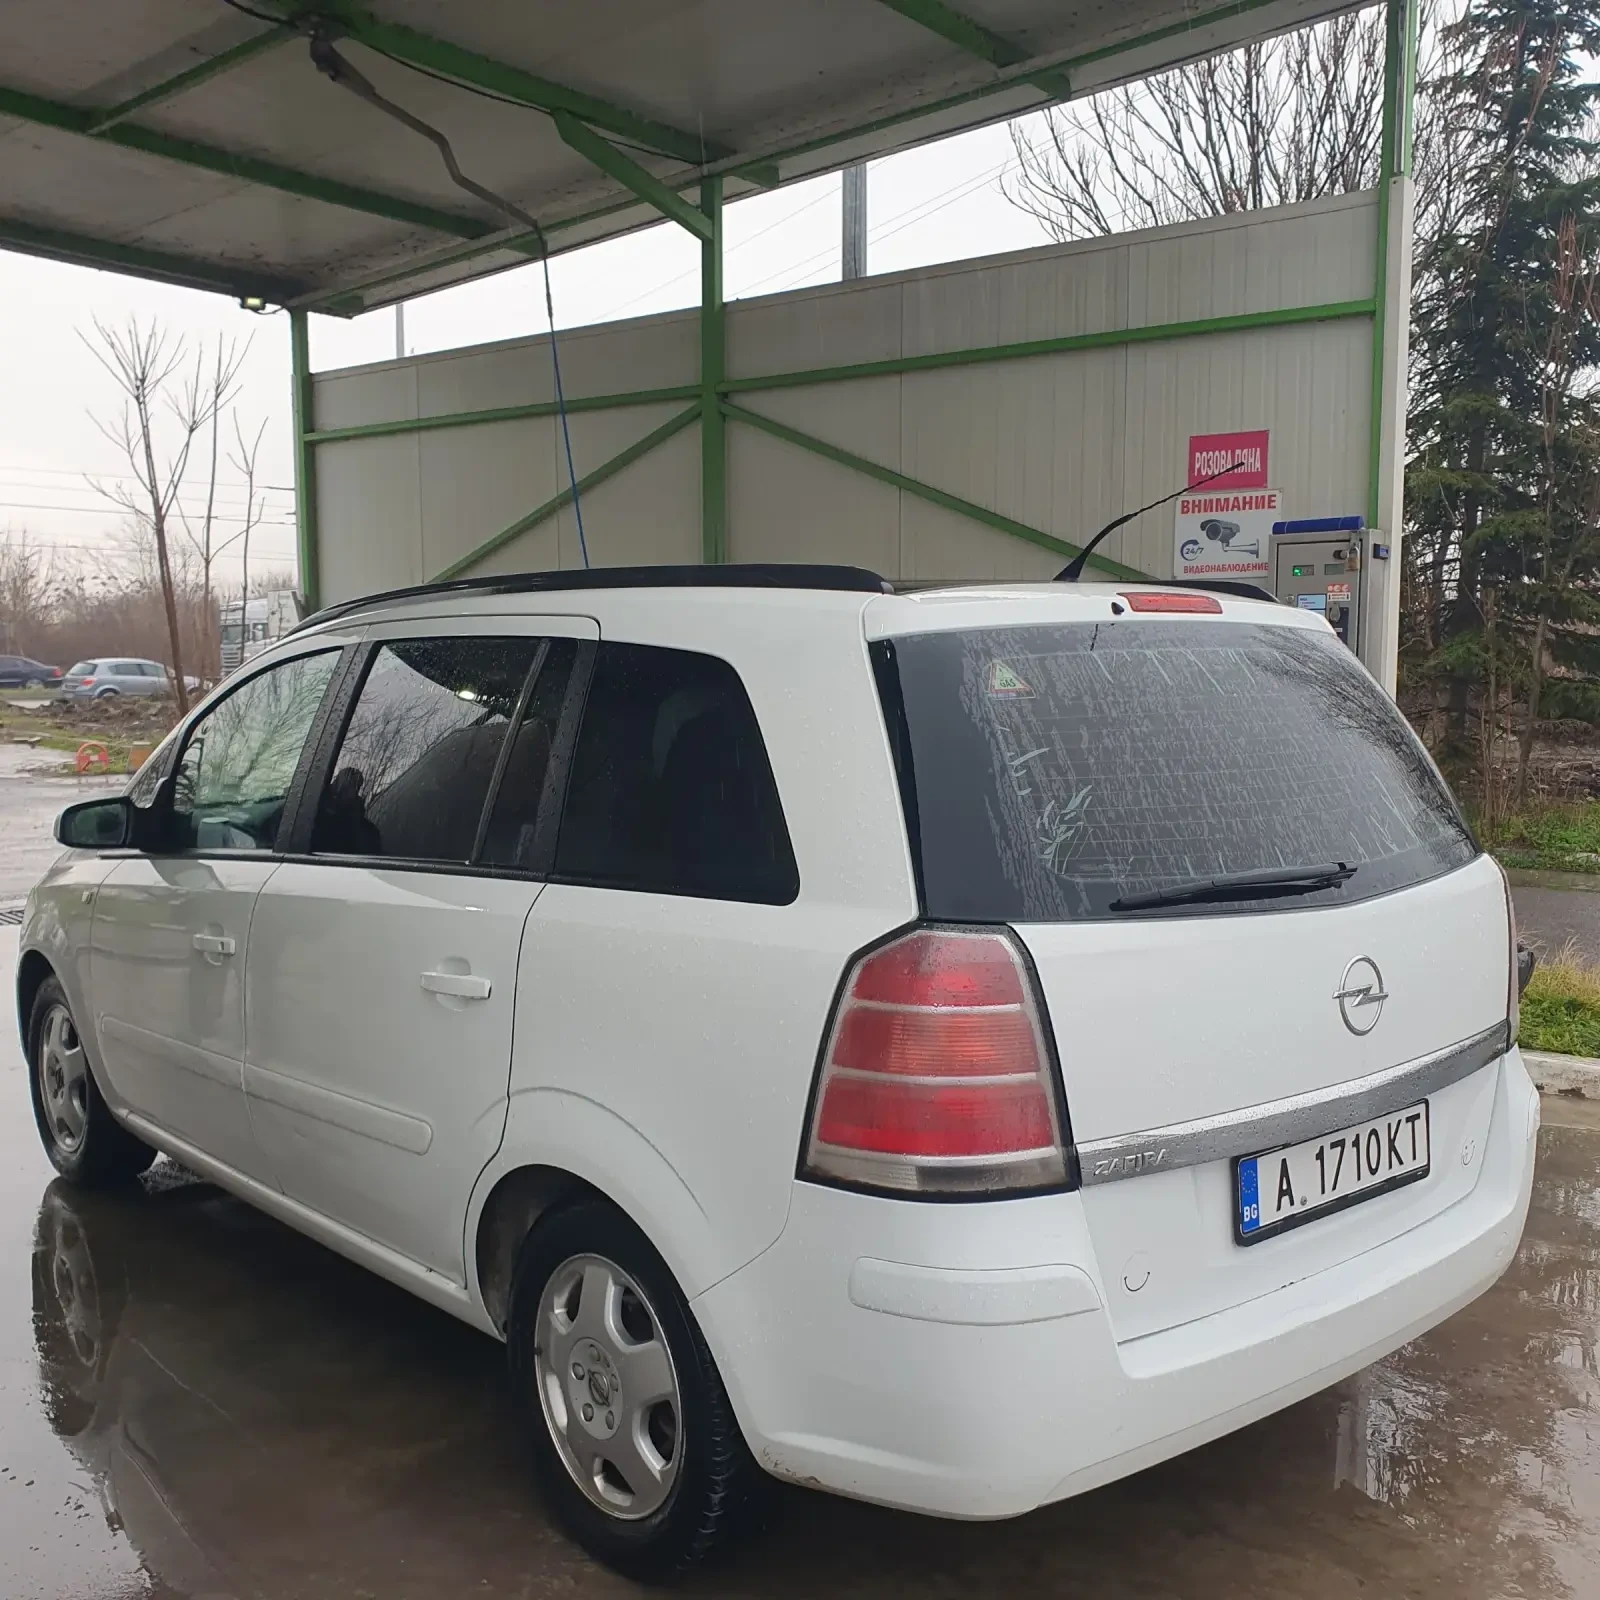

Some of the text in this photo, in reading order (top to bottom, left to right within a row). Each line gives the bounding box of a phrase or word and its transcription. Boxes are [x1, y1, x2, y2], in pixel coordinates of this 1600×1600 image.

[1195, 448, 1261, 476] РОЗОВА ПЯНА
[1180, 494, 1277, 515] ВНИМАНИЕ
[1184, 546, 1204, 556] 24/7
[1183, 562, 1269, 574] ВИДЕОНАБЛЮДЕНИЕ
[999, 678, 1017, 688] GAS
[1276, 1157, 1295, 1212] A
[1243, 1204, 1258, 1222] BG
